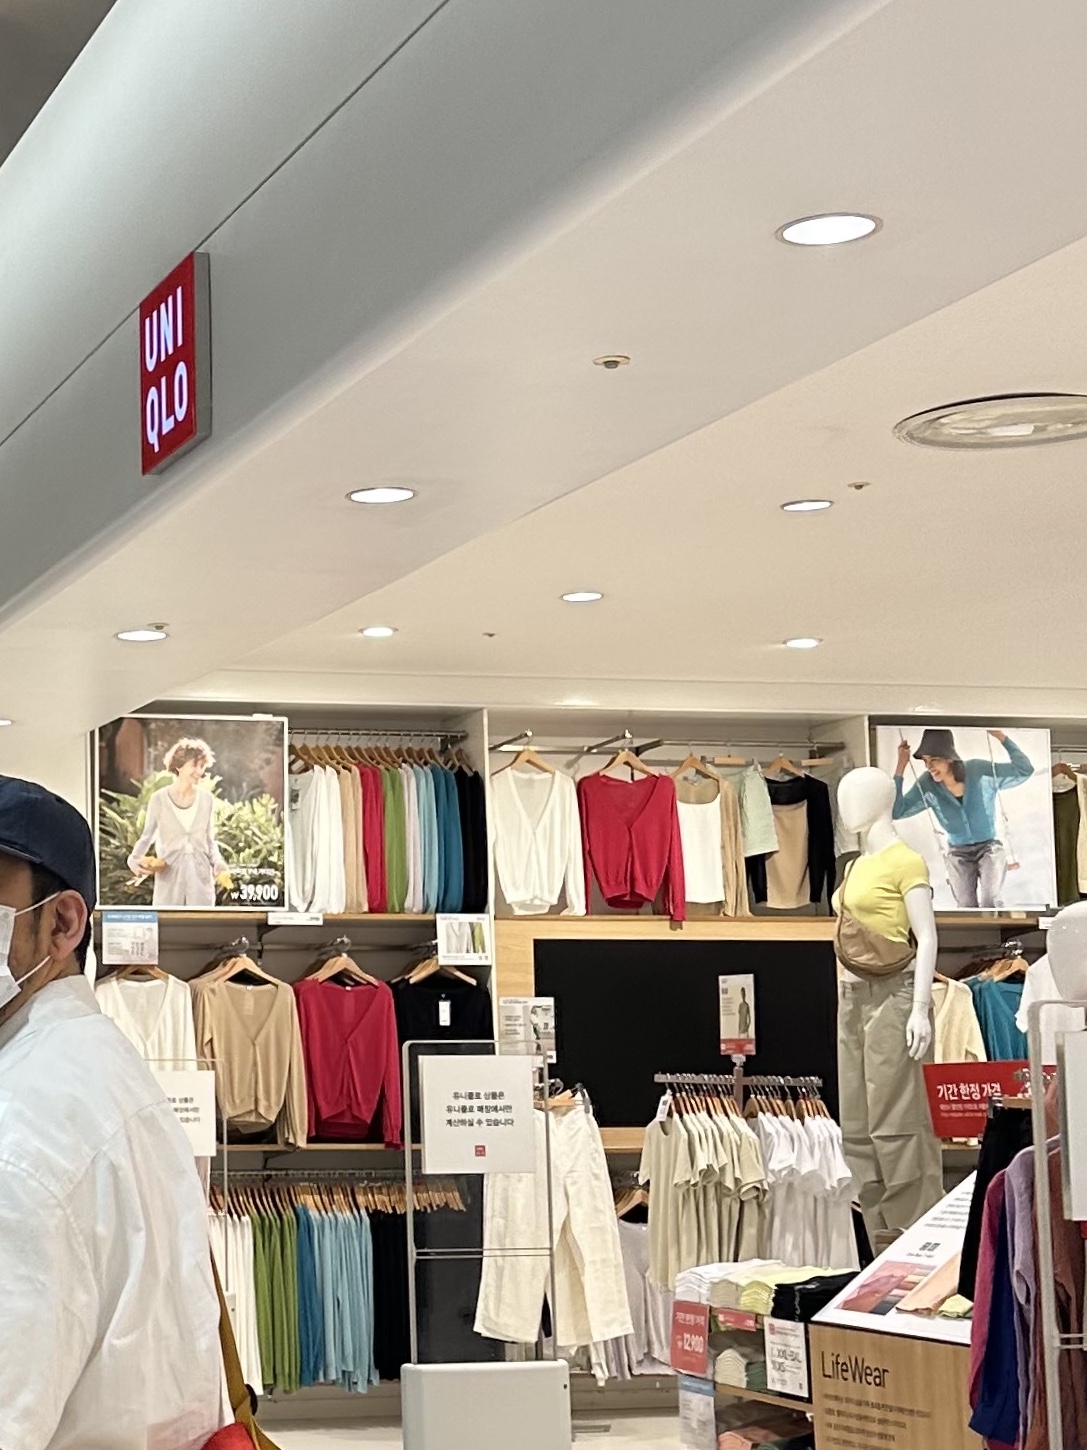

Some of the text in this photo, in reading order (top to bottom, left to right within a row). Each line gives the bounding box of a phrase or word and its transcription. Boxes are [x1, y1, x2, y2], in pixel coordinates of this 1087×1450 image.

[145, 286, 183, 372] UNI
[146, 361, 188, 453] QLO
[937, 1083, 958, 1100] 기간
[959, 1082, 980, 1100] 한정
[821, 1350, 889, 1388] LifeWear
